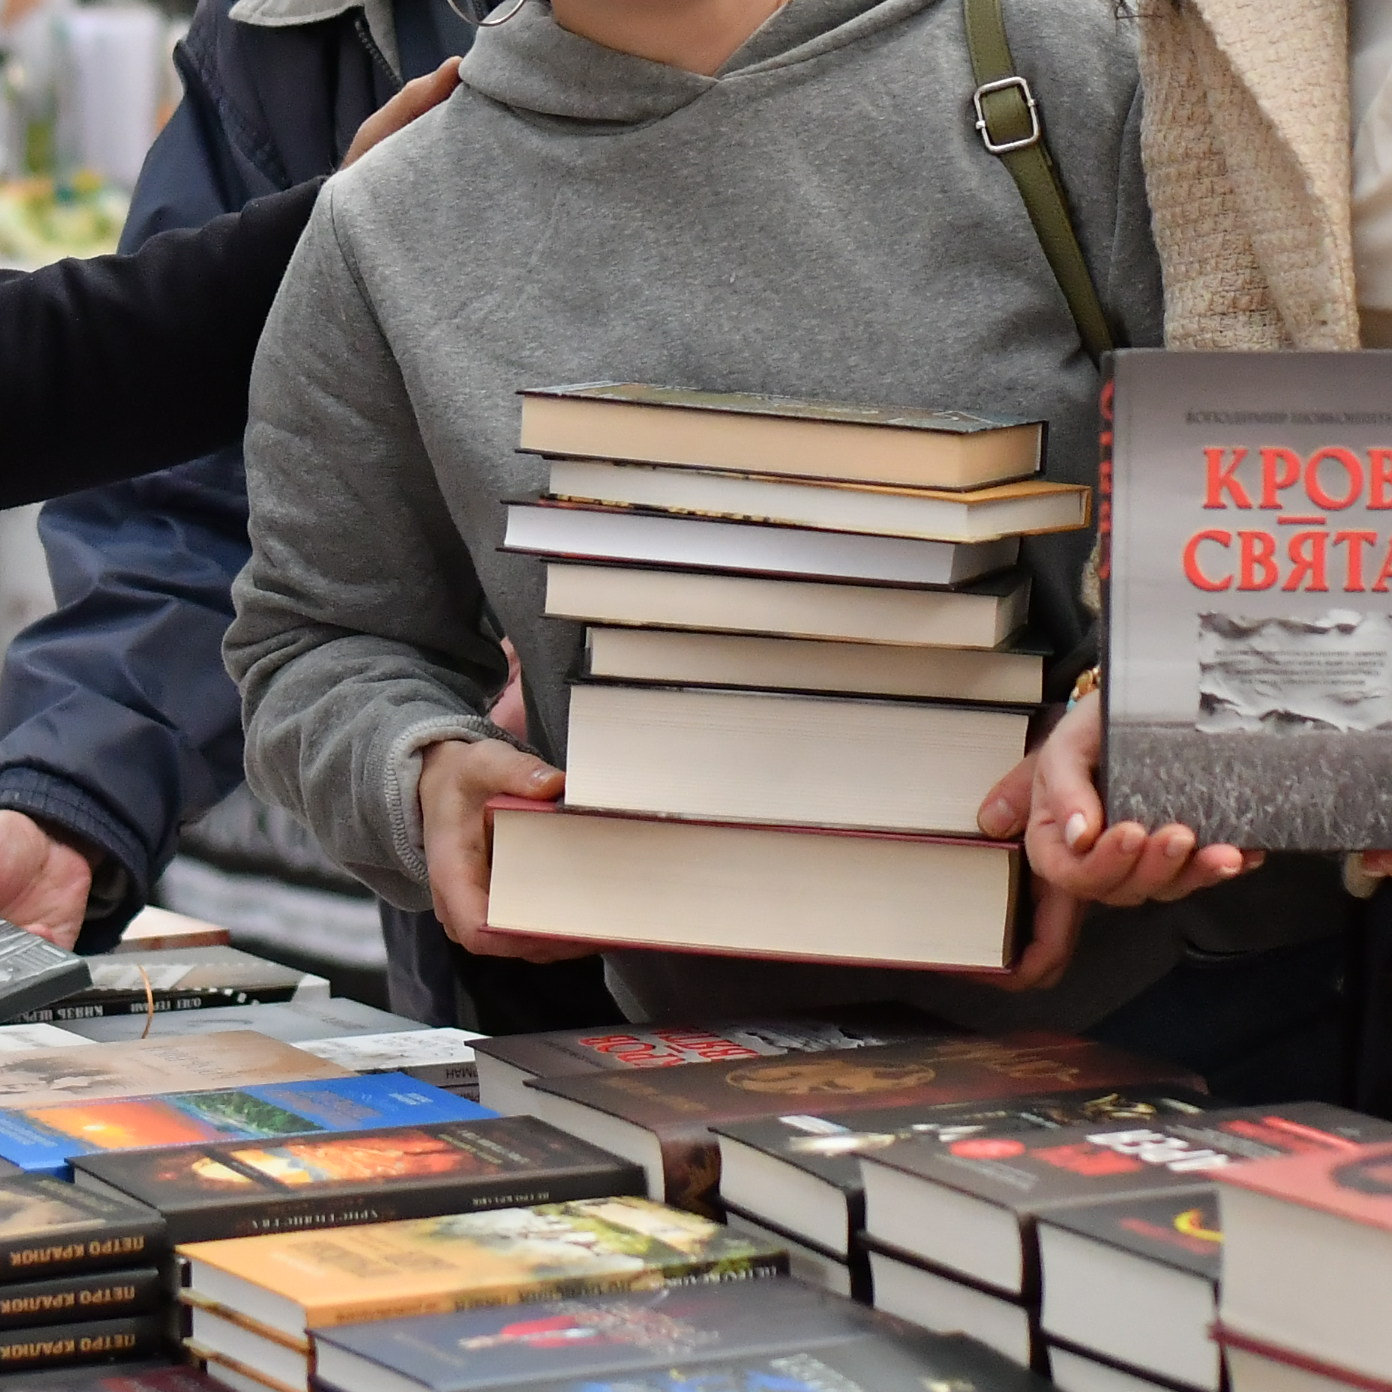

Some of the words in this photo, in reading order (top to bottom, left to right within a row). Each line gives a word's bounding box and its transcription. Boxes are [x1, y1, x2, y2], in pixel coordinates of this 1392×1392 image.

[10, 1242, 85, 1267] КРАЛЮК
[88, 1234, 146, 1256] ПЕТРО
[0, 1292, 75, 1317] КРАЛЮК
[78, 1285, 136, 1308] ПЕТРО
[0, 1337, 75, 1362] КРАЛЮК
[78, 1331, 136, 1353] ПЕТРО
